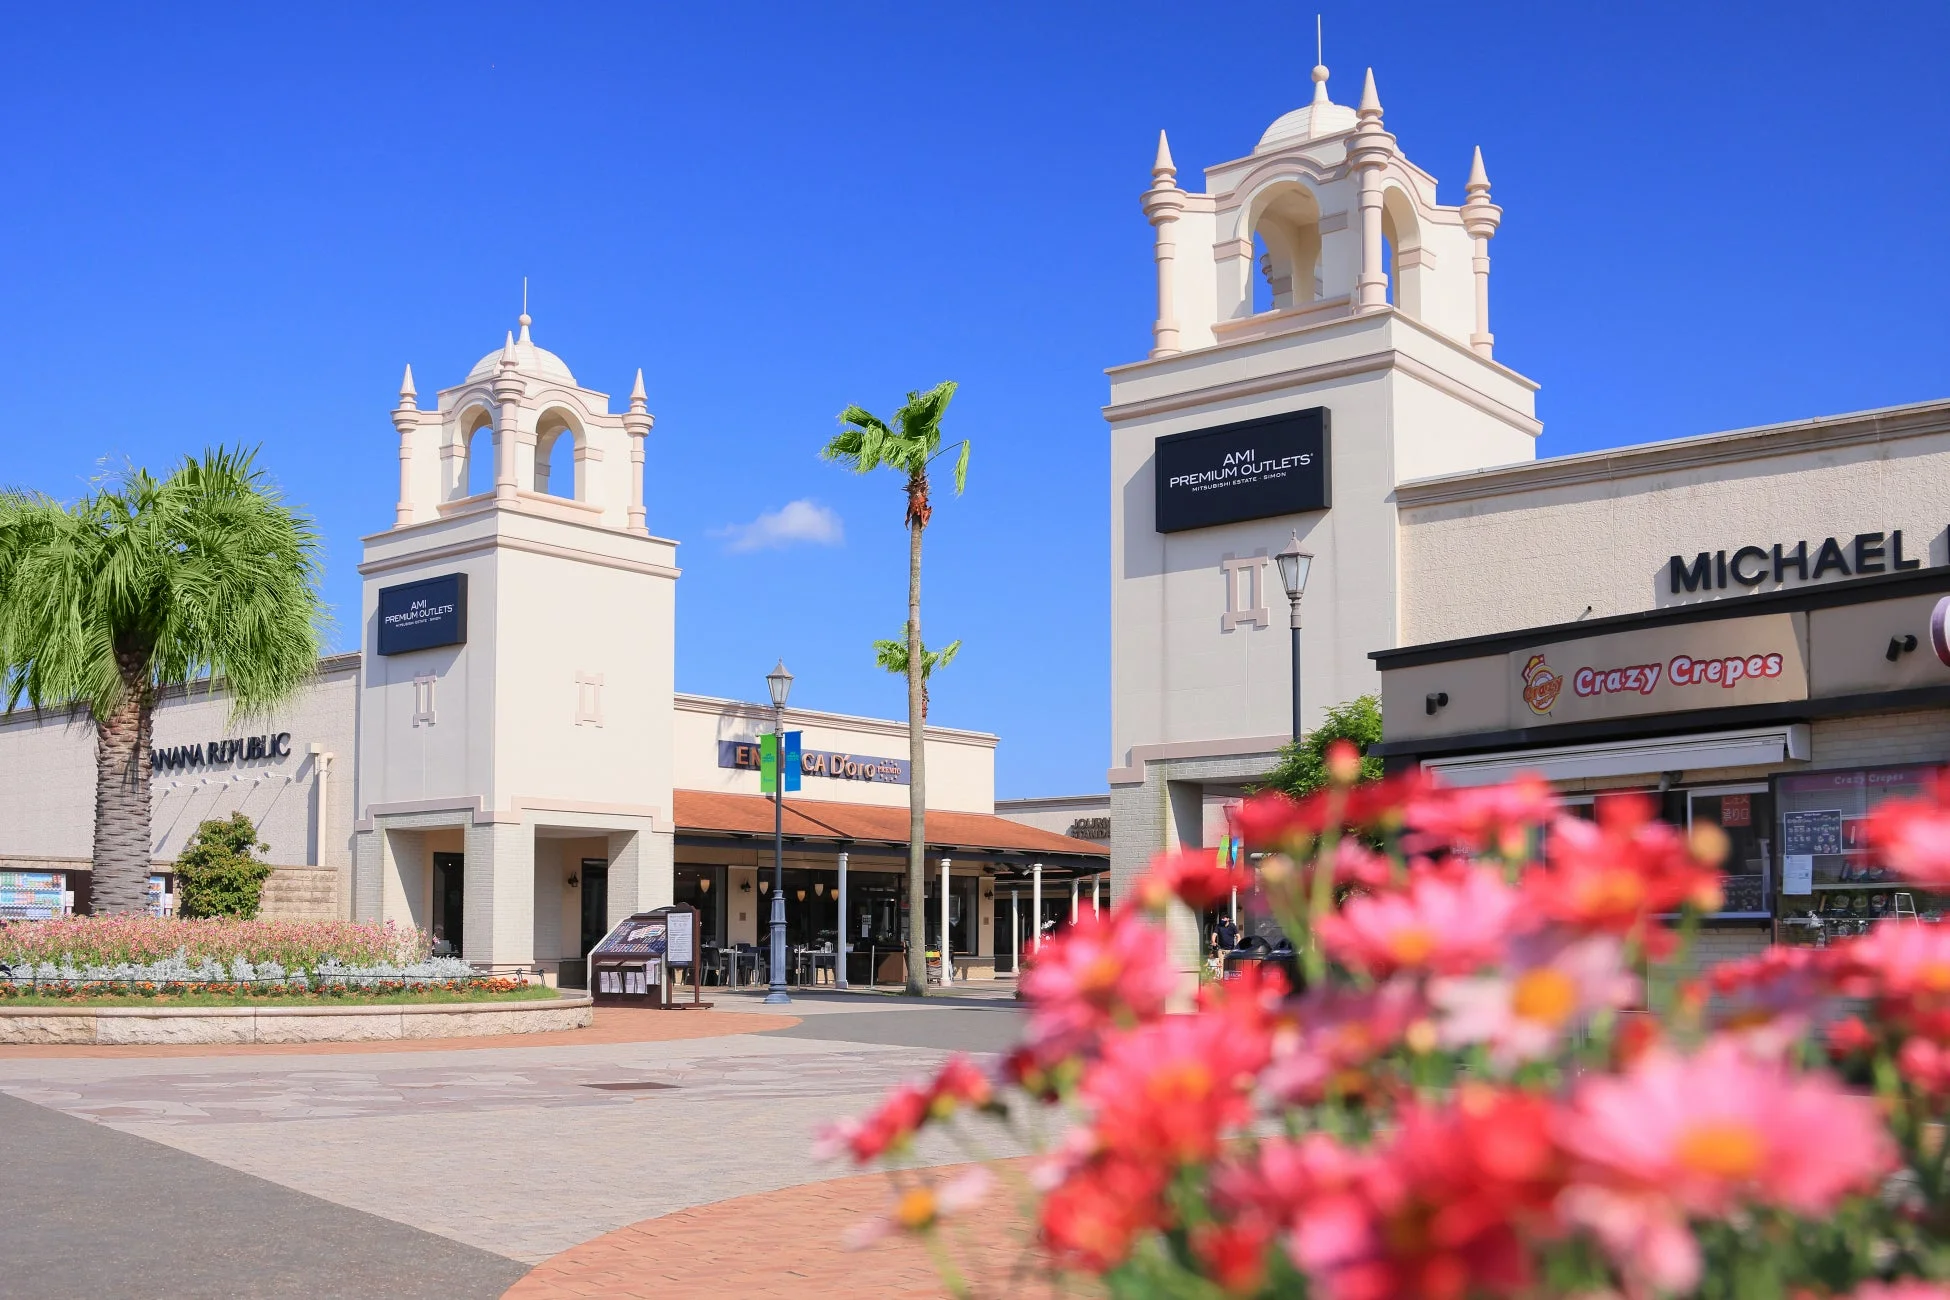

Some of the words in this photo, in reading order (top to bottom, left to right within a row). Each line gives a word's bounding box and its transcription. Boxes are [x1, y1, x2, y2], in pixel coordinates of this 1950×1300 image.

[1169, 466, 1238, 488] PREMIUM
[1240, 454, 1311, 476] OUTLETS
[1222, 449, 1255, 467] AMI
[1192, 481, 1230, 492] MITSUBISHI
[1232, 476, 1257, 486] ESTATE
[1263, 471, 1287, 481] SIMON
[1670, 530, 1919, 593] MICHAEL
[385, 611, 418, 624] PREMIUM
[411, 600, 427, 611] AMI
[1573, 662, 1662, 697] Crazy
[1668, 653, 1783, 689] Crepes
[150, 743, 205, 771] ANANA
[207, 732, 291, 764] REPUBLIC
[736, 746, 825, 773] ENCA
